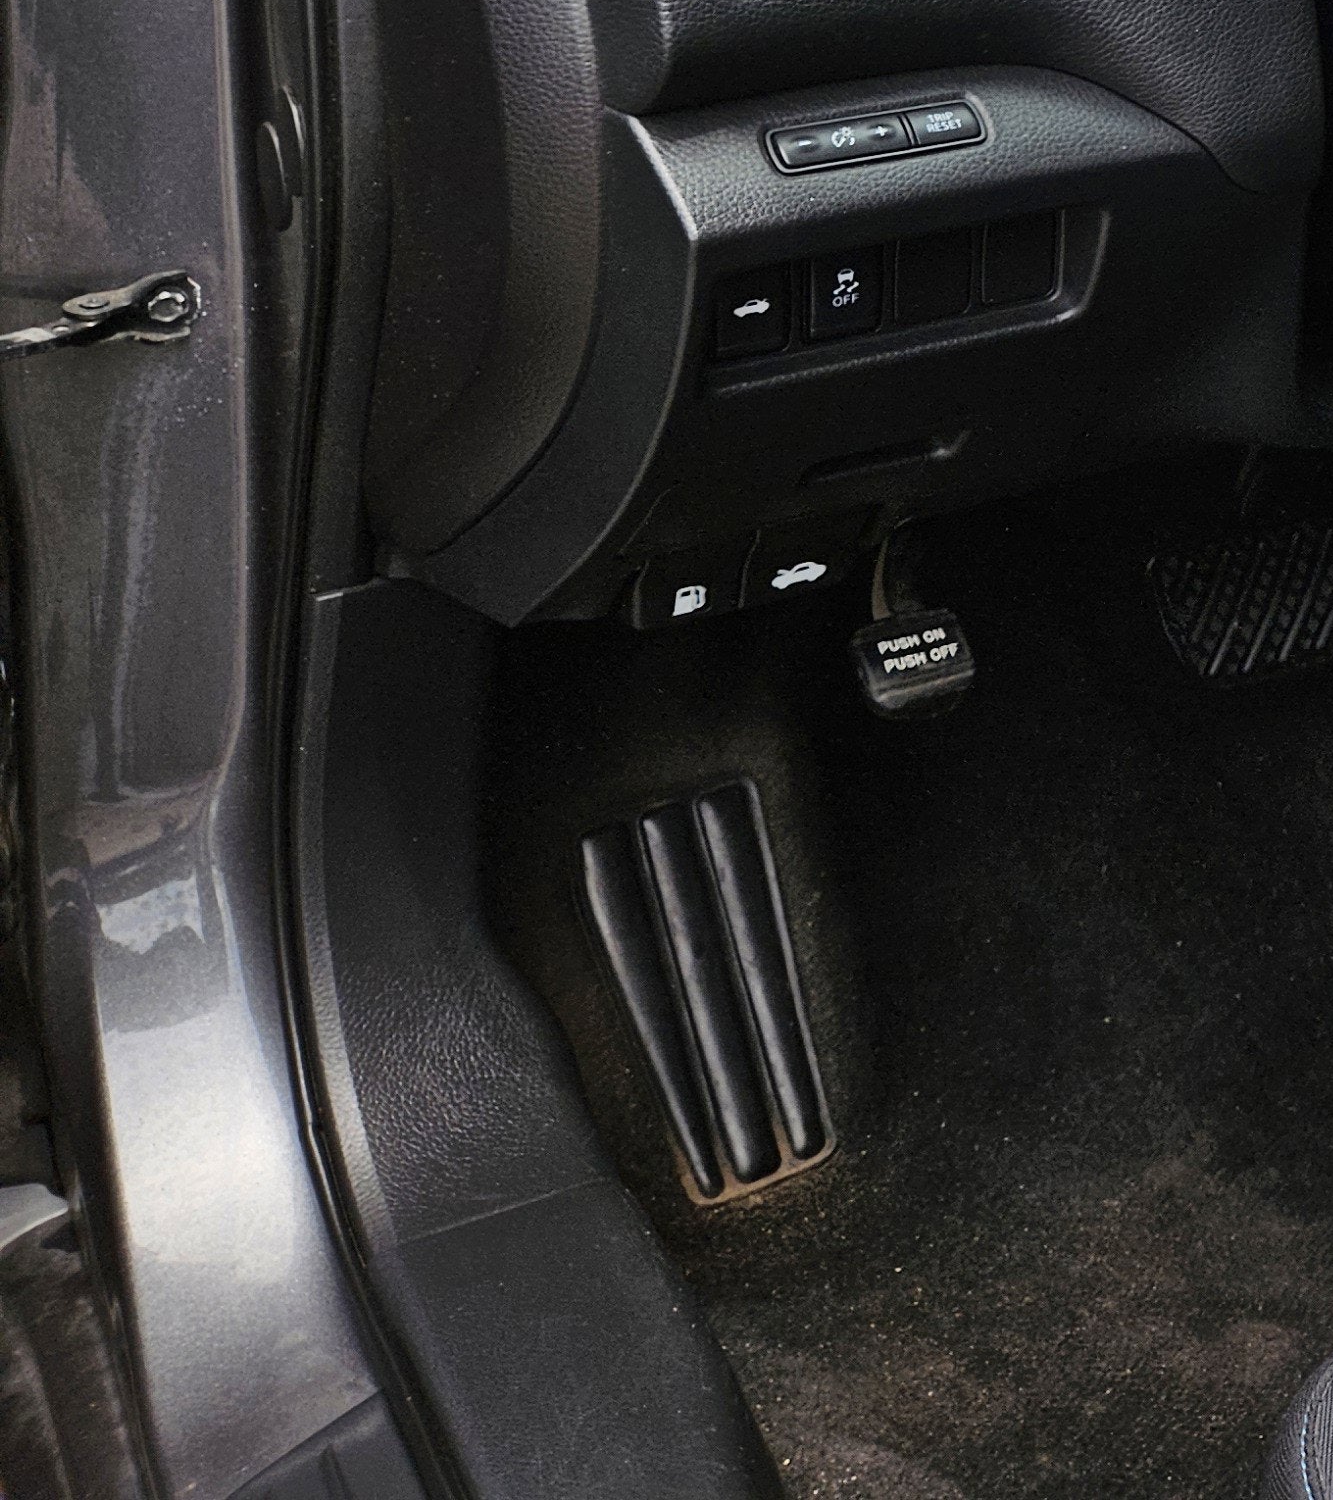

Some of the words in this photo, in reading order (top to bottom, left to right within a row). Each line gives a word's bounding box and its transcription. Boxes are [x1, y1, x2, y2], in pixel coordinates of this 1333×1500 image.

[926, 111, 954, 123] TRIP
[926, 119, 962, 133] RESET
[832, 292, 860, 307] OFF
[877, 633, 921, 655] PUSH
[922, 627, 946, 644] ON
[883, 651, 928, 674] PUSH
[929, 642, 959, 662] OFF
